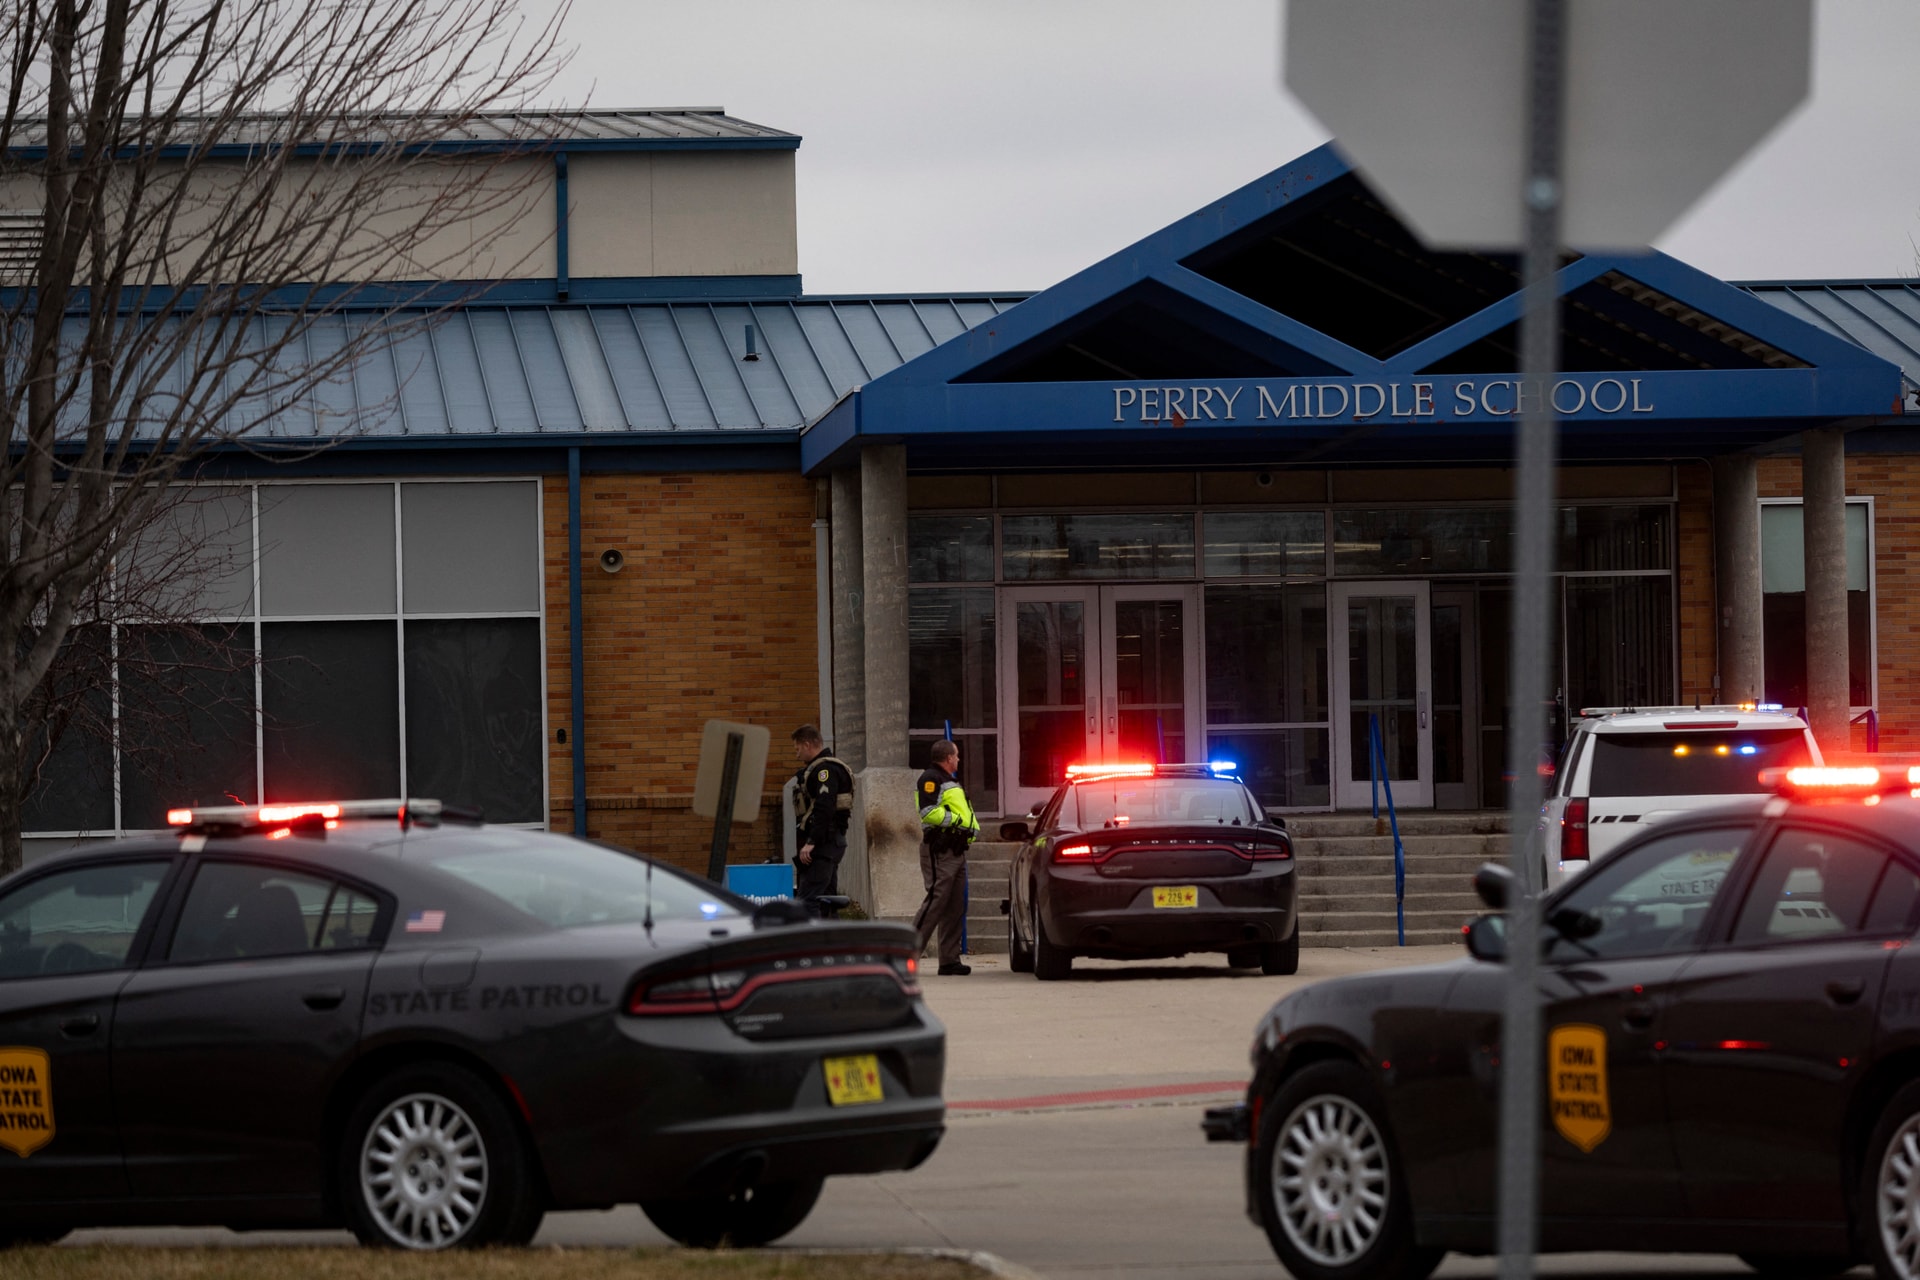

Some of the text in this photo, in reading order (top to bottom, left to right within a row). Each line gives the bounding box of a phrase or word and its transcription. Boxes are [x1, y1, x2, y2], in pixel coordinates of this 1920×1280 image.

[1113, 378, 1654, 421] PERRY MIDDLE SCHOOL
[743, 893, 788, 905] dewalk
[1661, 881, 1700, 896] STAE
[369, 983, 610, 1016] STATE PATROL
[0, 1064, 37, 1085] OWA
[0, 1087, 42, 1108] TATE
[0, 1111, 50, 1131] ATROL
